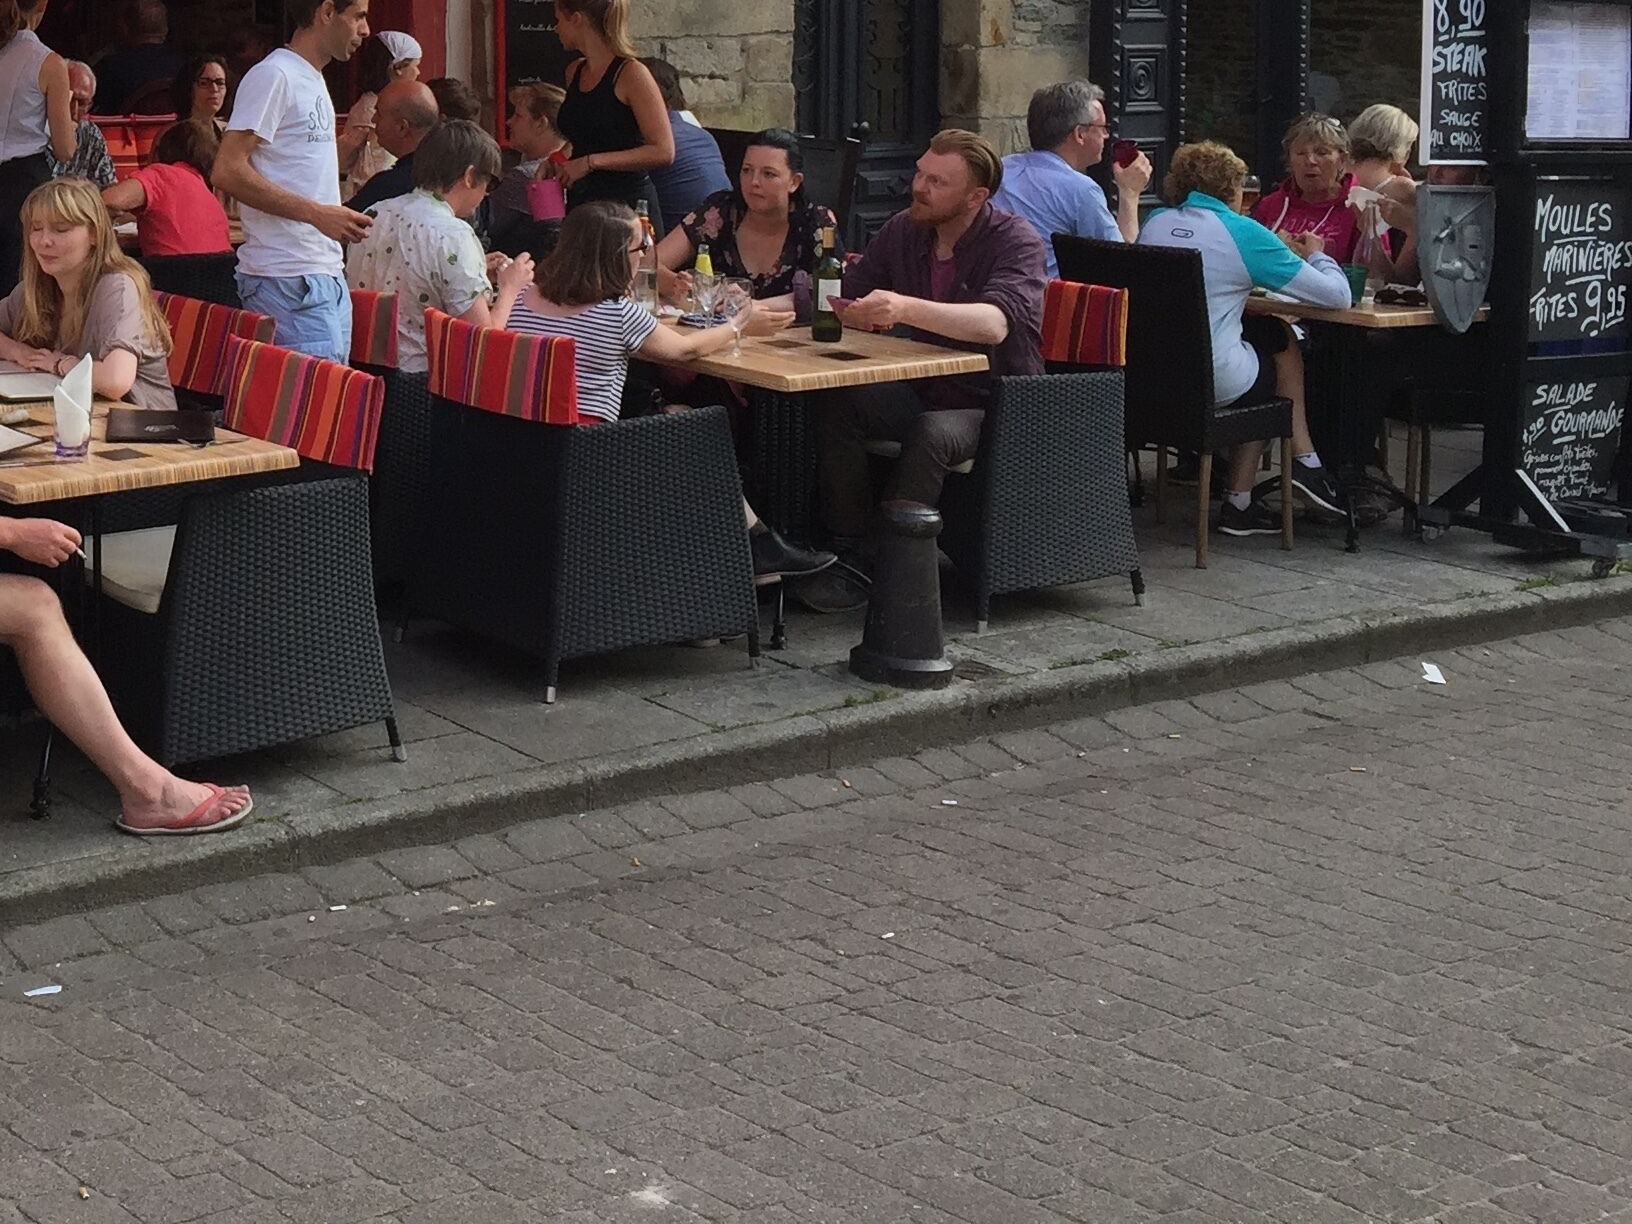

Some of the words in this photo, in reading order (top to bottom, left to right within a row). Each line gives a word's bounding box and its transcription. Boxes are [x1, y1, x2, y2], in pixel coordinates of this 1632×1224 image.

[1432, 42, 1487, 78] STEAK
[1534, 194, 1612, 243] MOULES
[1532, 382, 1597, 406] SALADE
